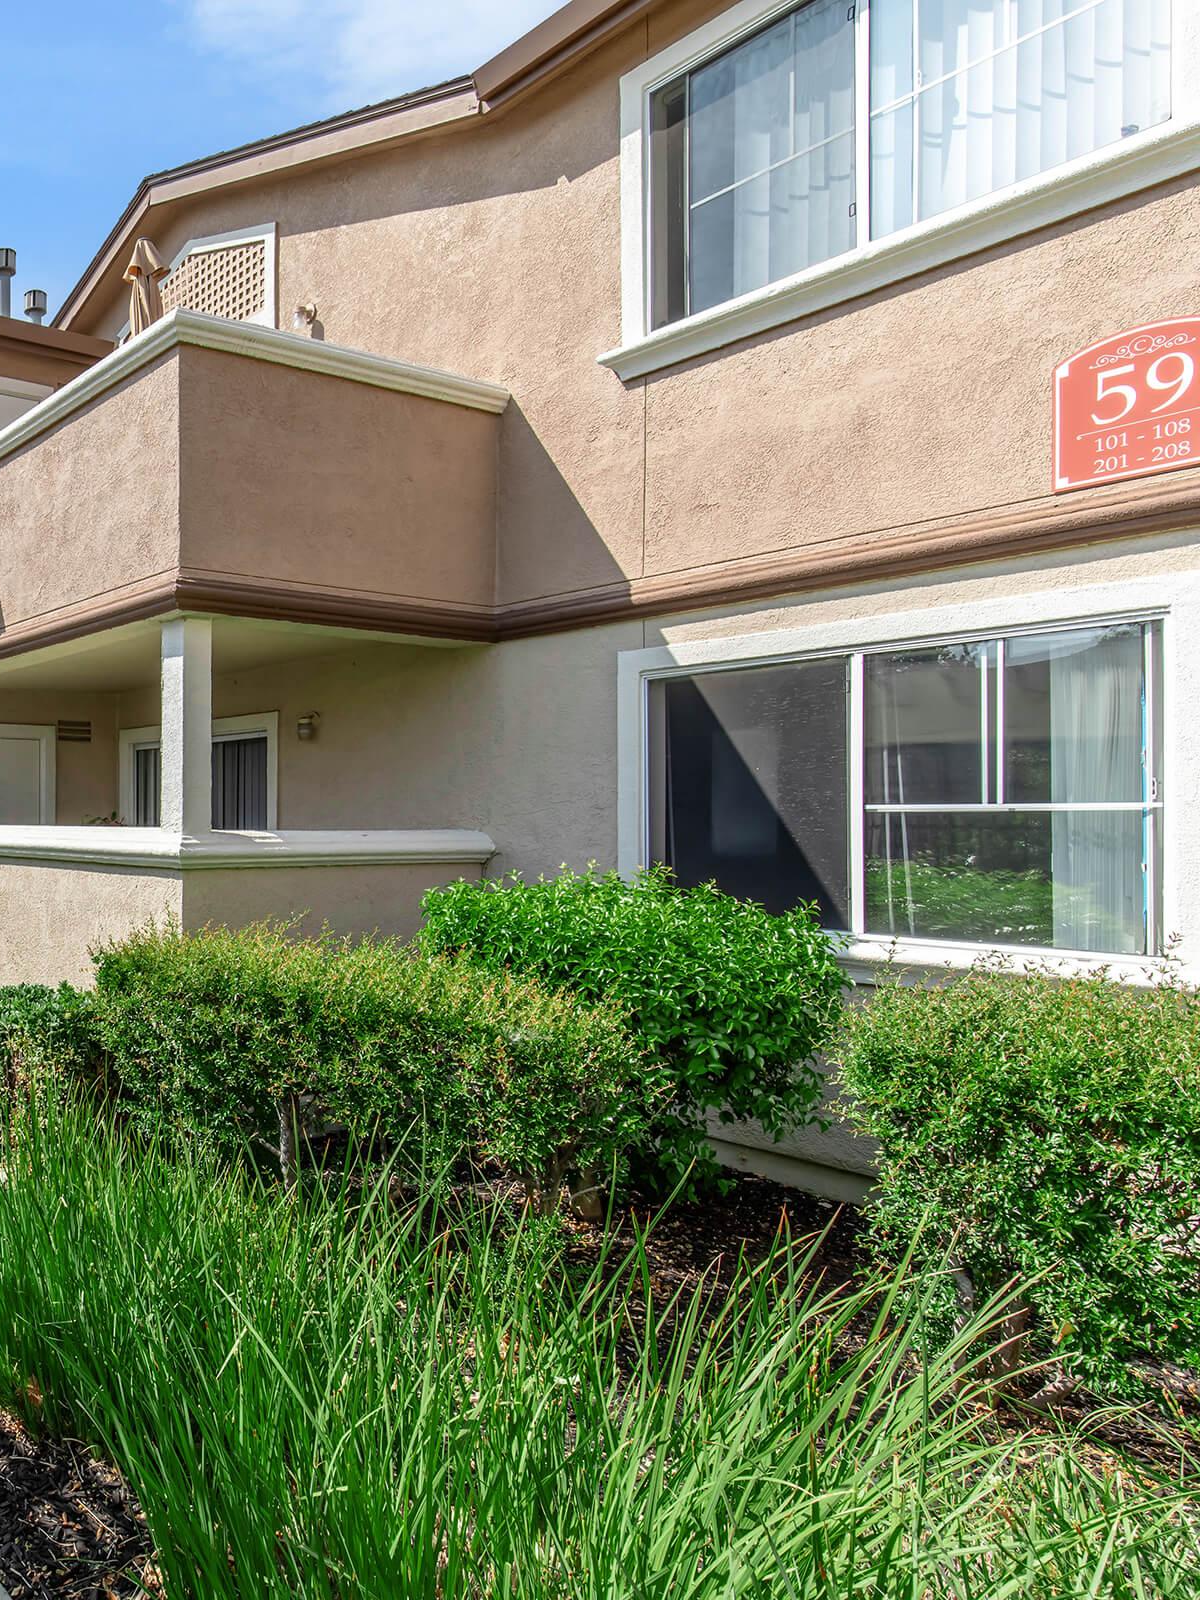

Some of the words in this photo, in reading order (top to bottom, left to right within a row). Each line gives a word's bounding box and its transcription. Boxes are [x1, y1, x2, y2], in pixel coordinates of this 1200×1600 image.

[1091, 352, 1194, 425] 59
[1095, 432, 1128, 453] 101
[1153, 418, 1191, 440] 108
[1093, 454, 1128, 474] 201
[1152, 440, 1191, 462] 208
